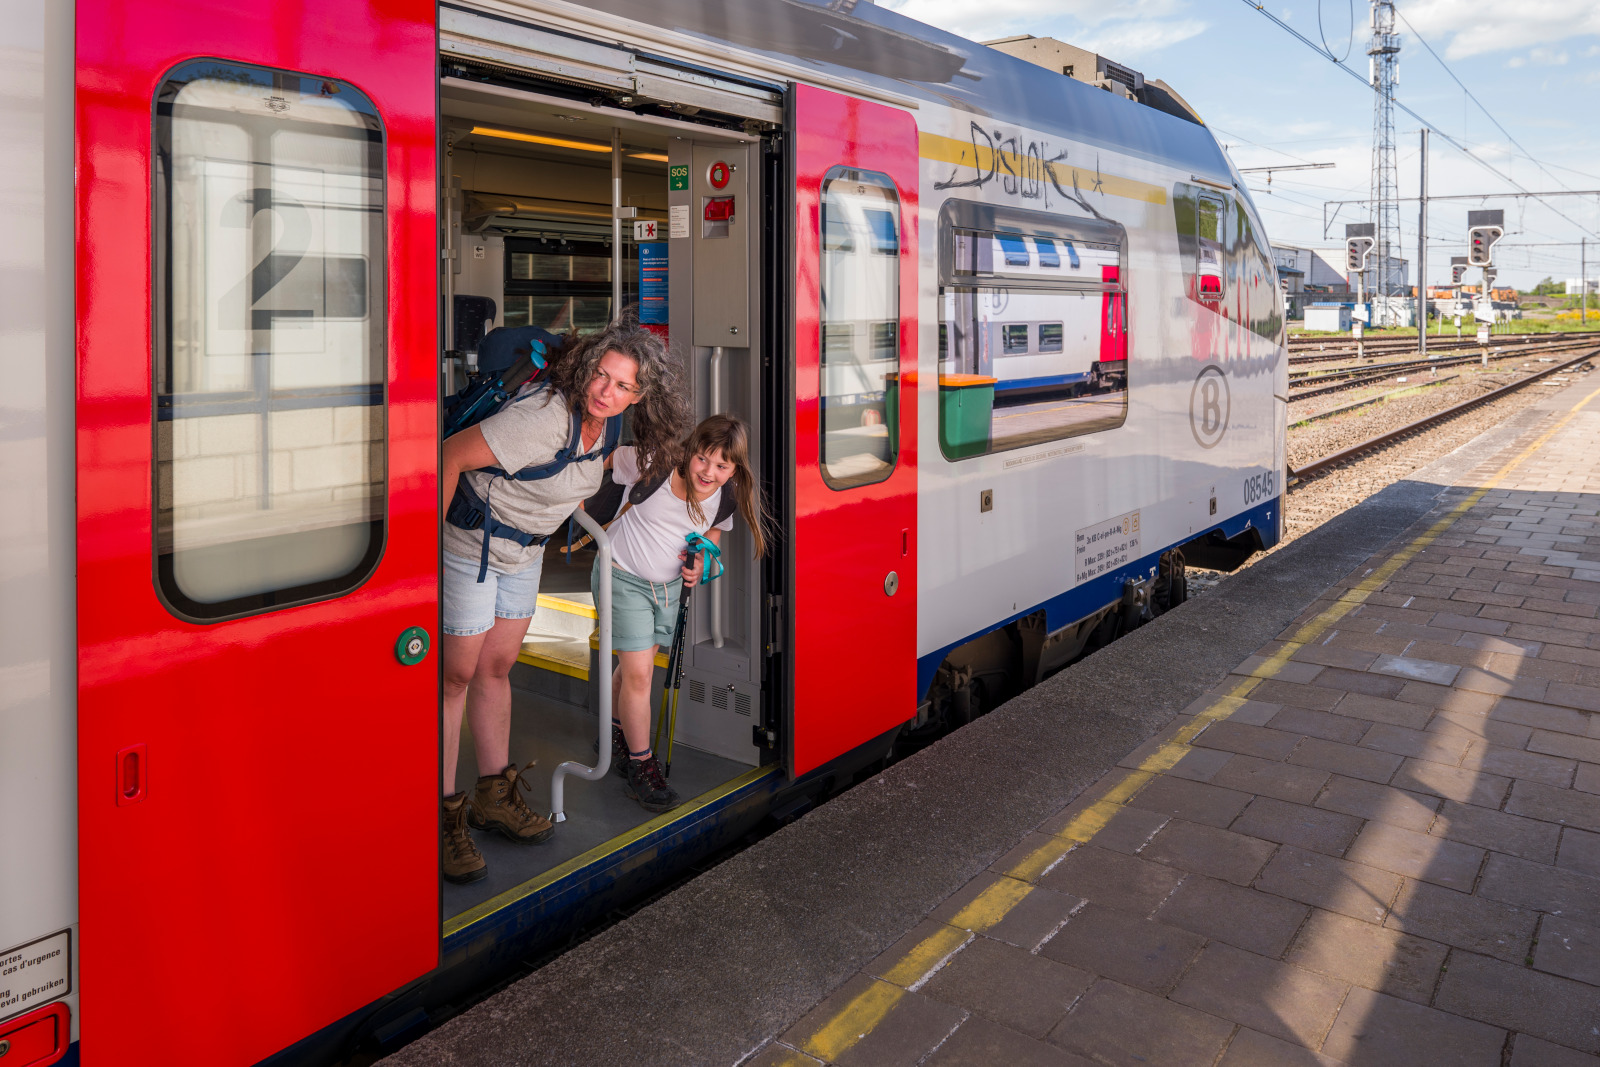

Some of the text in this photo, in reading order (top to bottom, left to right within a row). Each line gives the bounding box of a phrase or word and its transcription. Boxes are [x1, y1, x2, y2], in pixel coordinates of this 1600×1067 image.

[671, 167, 688, 177] SOS
[637, 223, 643, 238] 1
[217, 188, 314, 330] 2
[1243, 470, 1273, 506] 08545
[3, 949, 61, 976] cas d'urgence
[22, 978, 64, 1001] gebruiken
